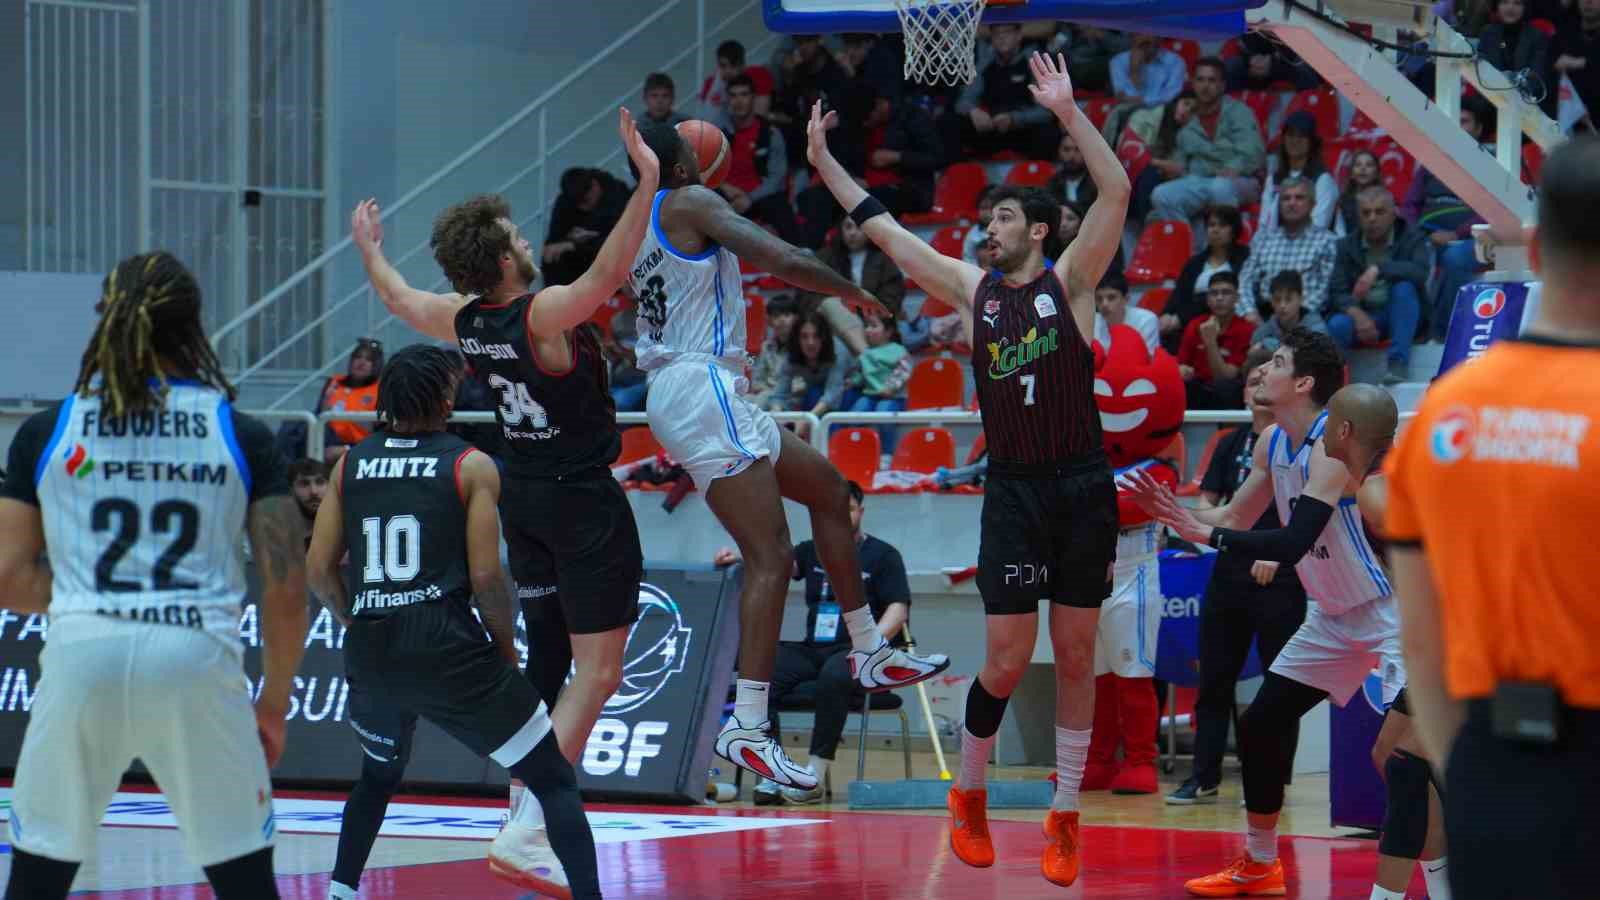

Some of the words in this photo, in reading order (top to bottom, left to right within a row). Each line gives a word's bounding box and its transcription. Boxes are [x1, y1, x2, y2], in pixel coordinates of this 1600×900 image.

[488, 373, 548, 429] 34
[1020, 374, 1036, 406] 7
[82, 409, 208, 438] FLOWERS
[355, 457, 440, 479] MINTZ
[90, 498, 200, 592] 22
[362, 514, 421, 583] 10
